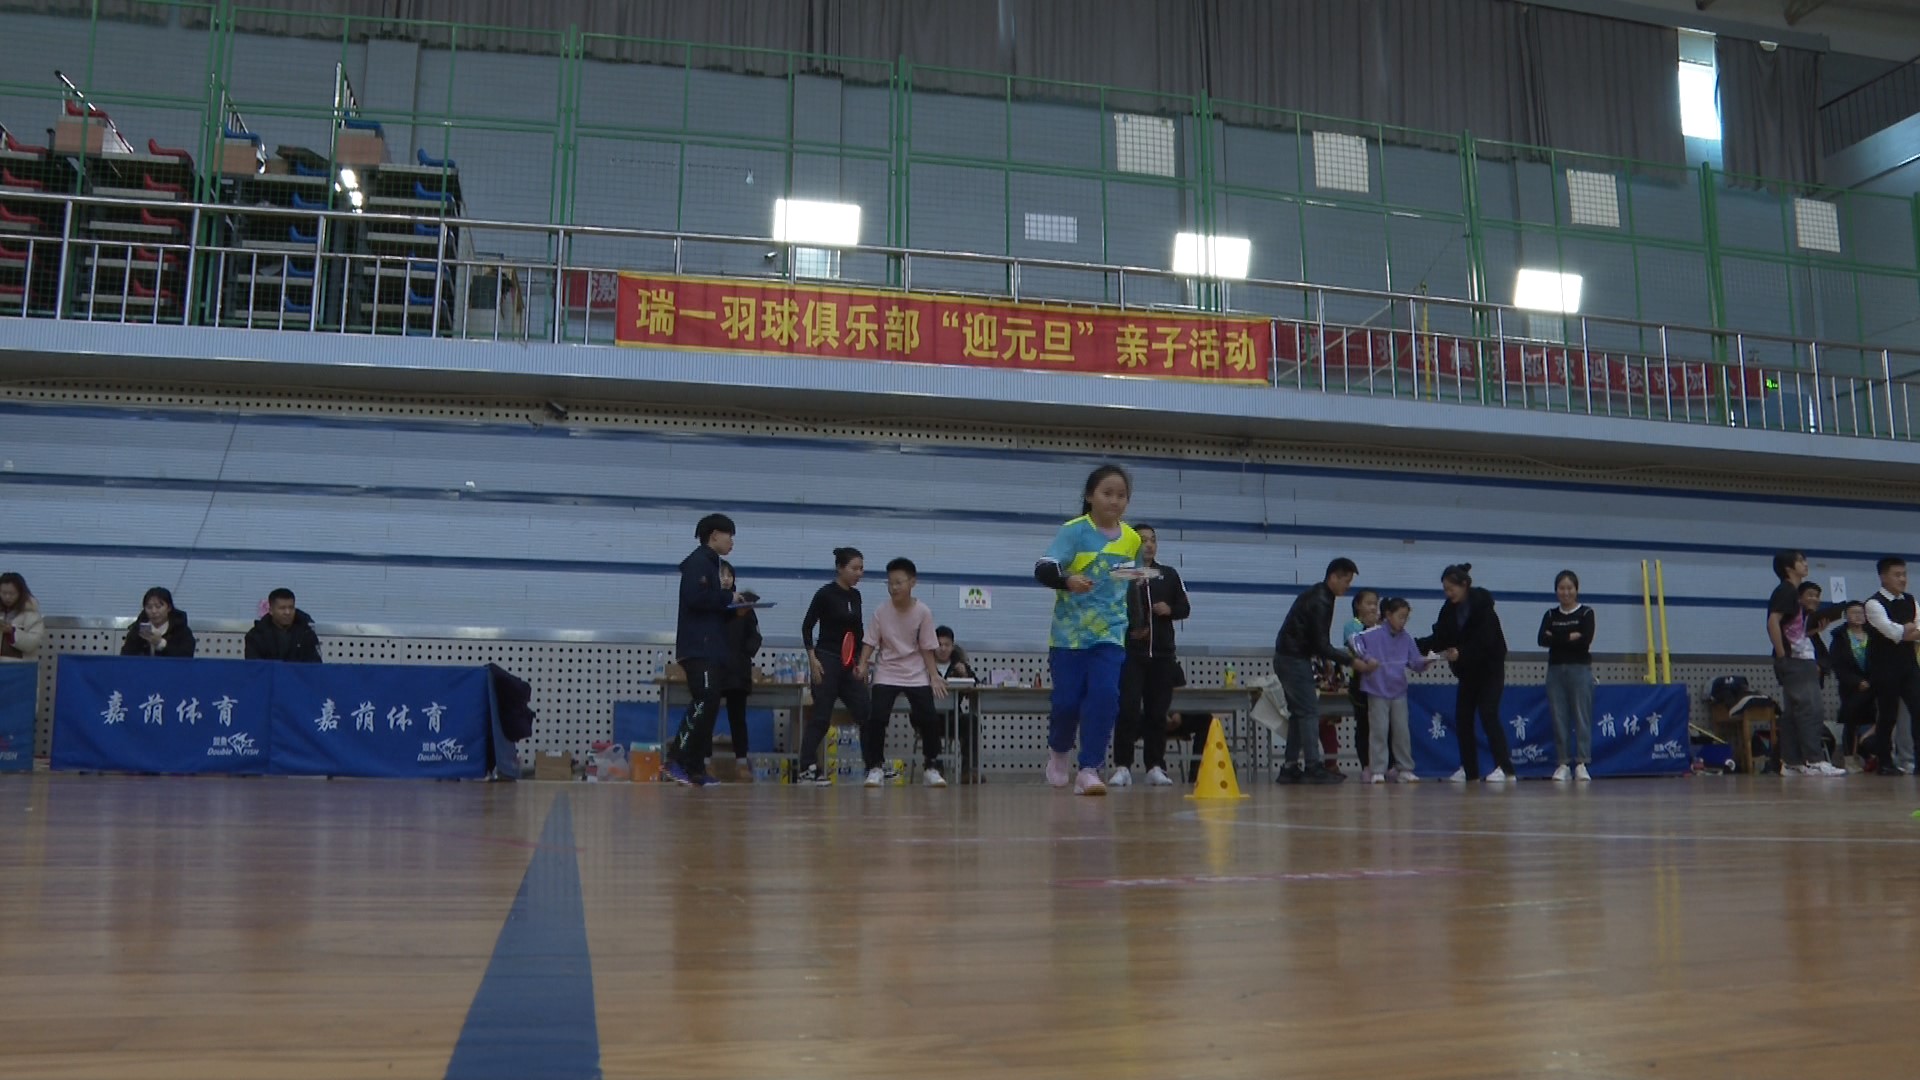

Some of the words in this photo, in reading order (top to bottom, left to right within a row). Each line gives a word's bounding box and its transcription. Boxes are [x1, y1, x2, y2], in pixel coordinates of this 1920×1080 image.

[638, 286, 1257, 372] 瑞一羽球俱乐部“迎元旦”亲子活动
[100, 690, 239, 727] 嘉荫体育
[314, 697, 448, 733] 嘉荫体育
[1597, 711, 1663, 739] 荫体育
